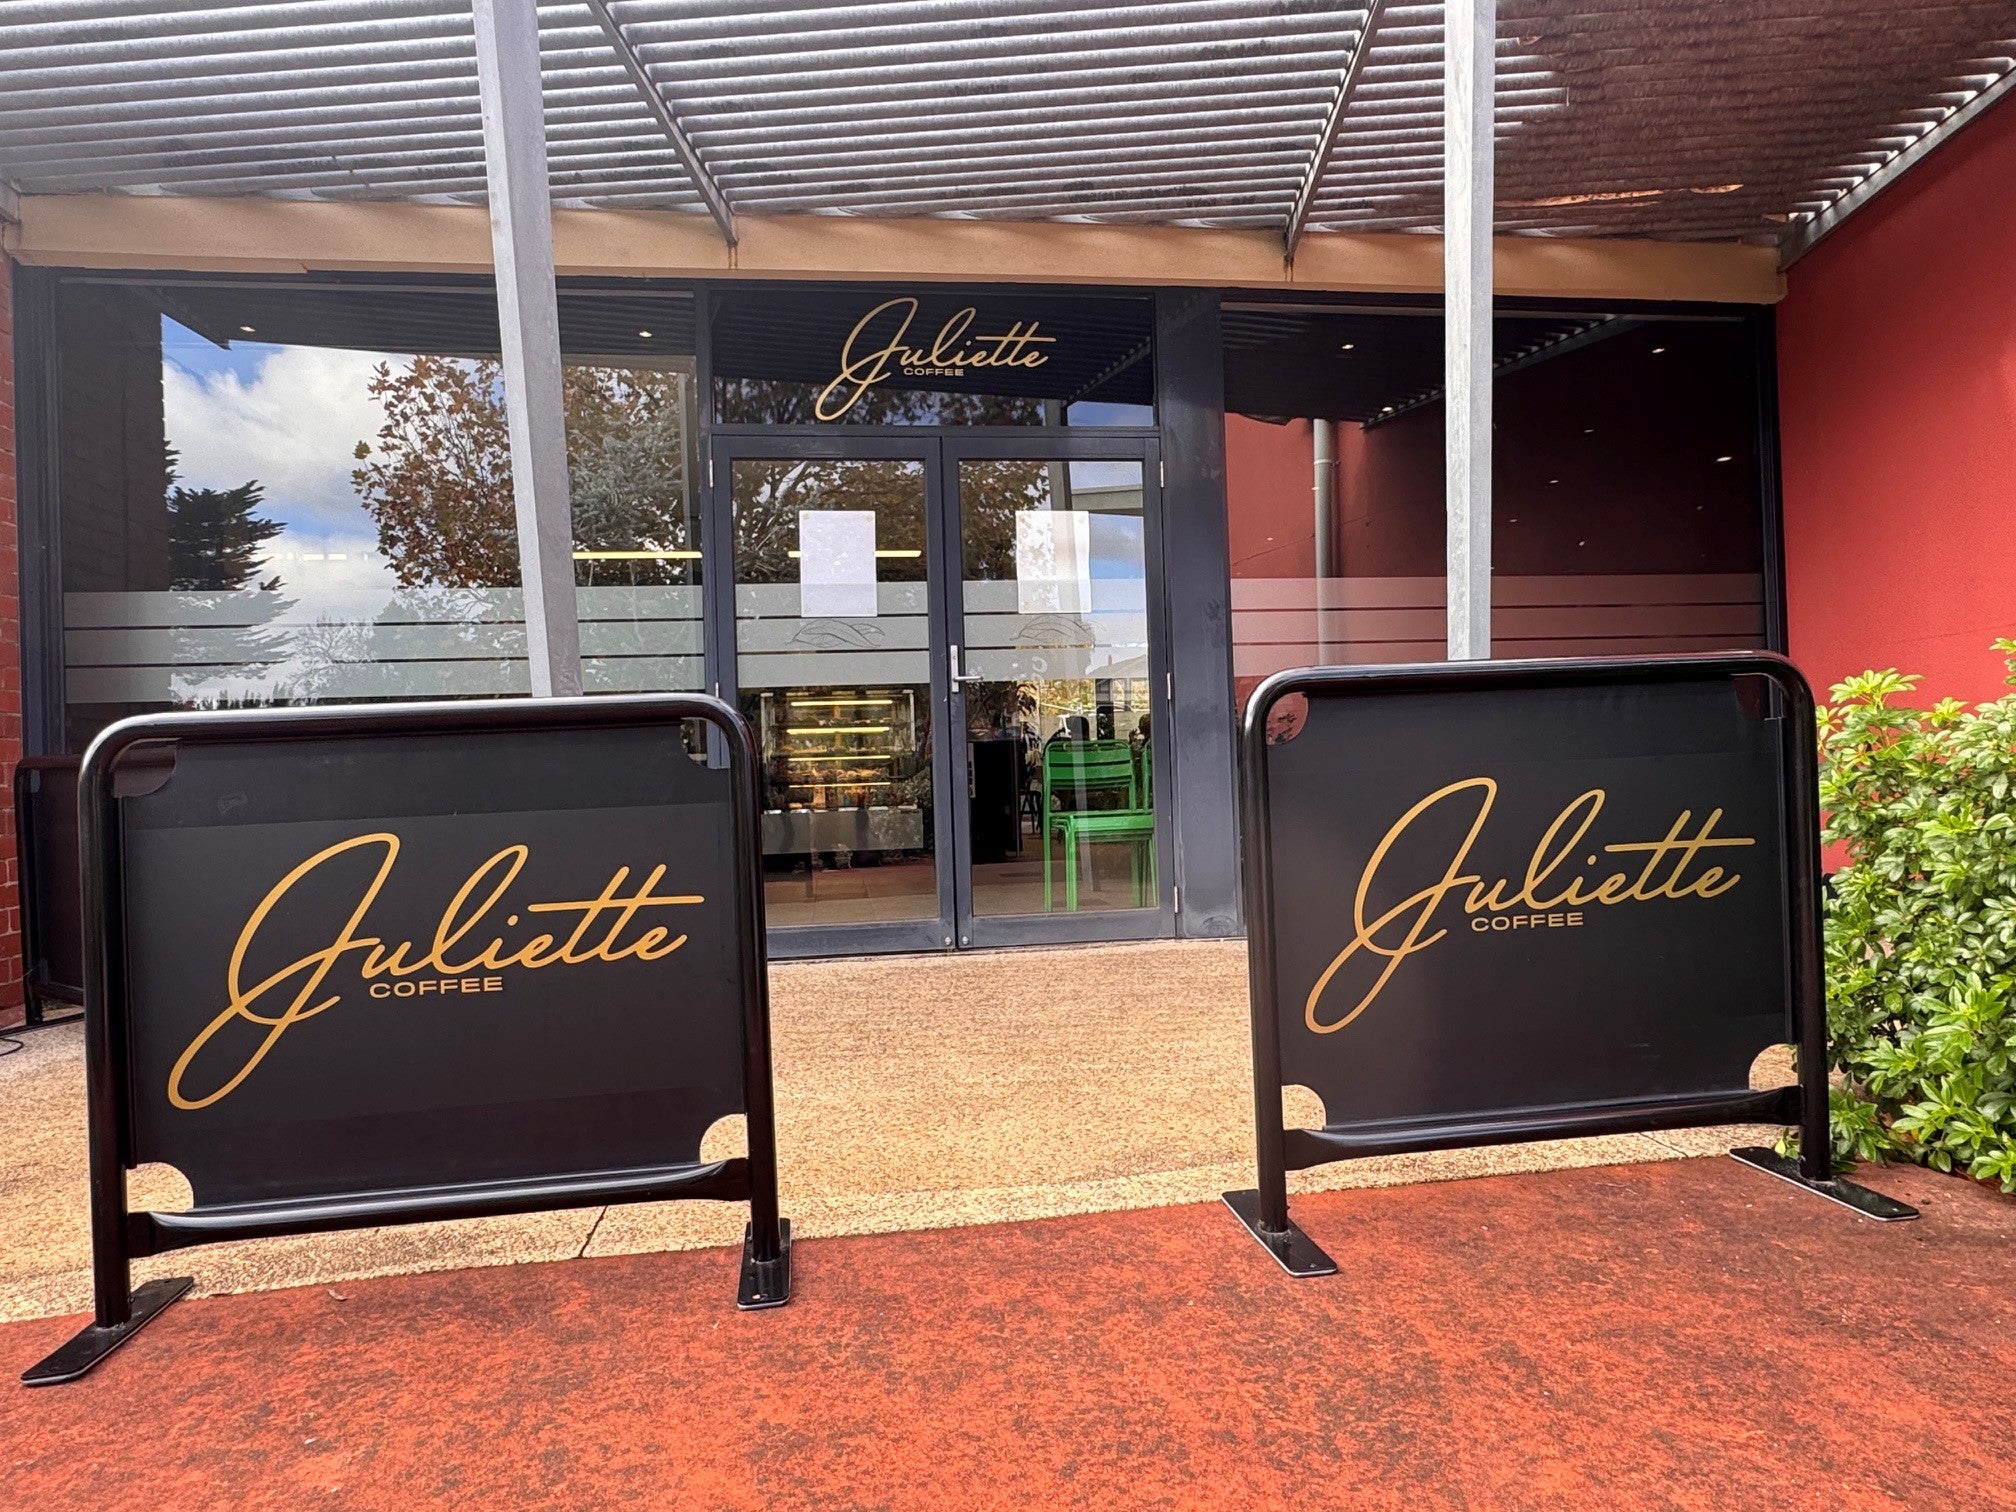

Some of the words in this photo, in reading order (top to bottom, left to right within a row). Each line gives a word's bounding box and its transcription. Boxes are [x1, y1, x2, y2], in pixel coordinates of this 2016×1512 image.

[815, 298, 1056, 421] Juliette
[903, 367, 965, 377] COFFEE
[1305, 777, 1755, 1034] Juliette
[1470, 911, 1583, 932] COFFEE
[168, 832, 705, 1110] Juliette
[369, 976, 503, 999] COFFEE
